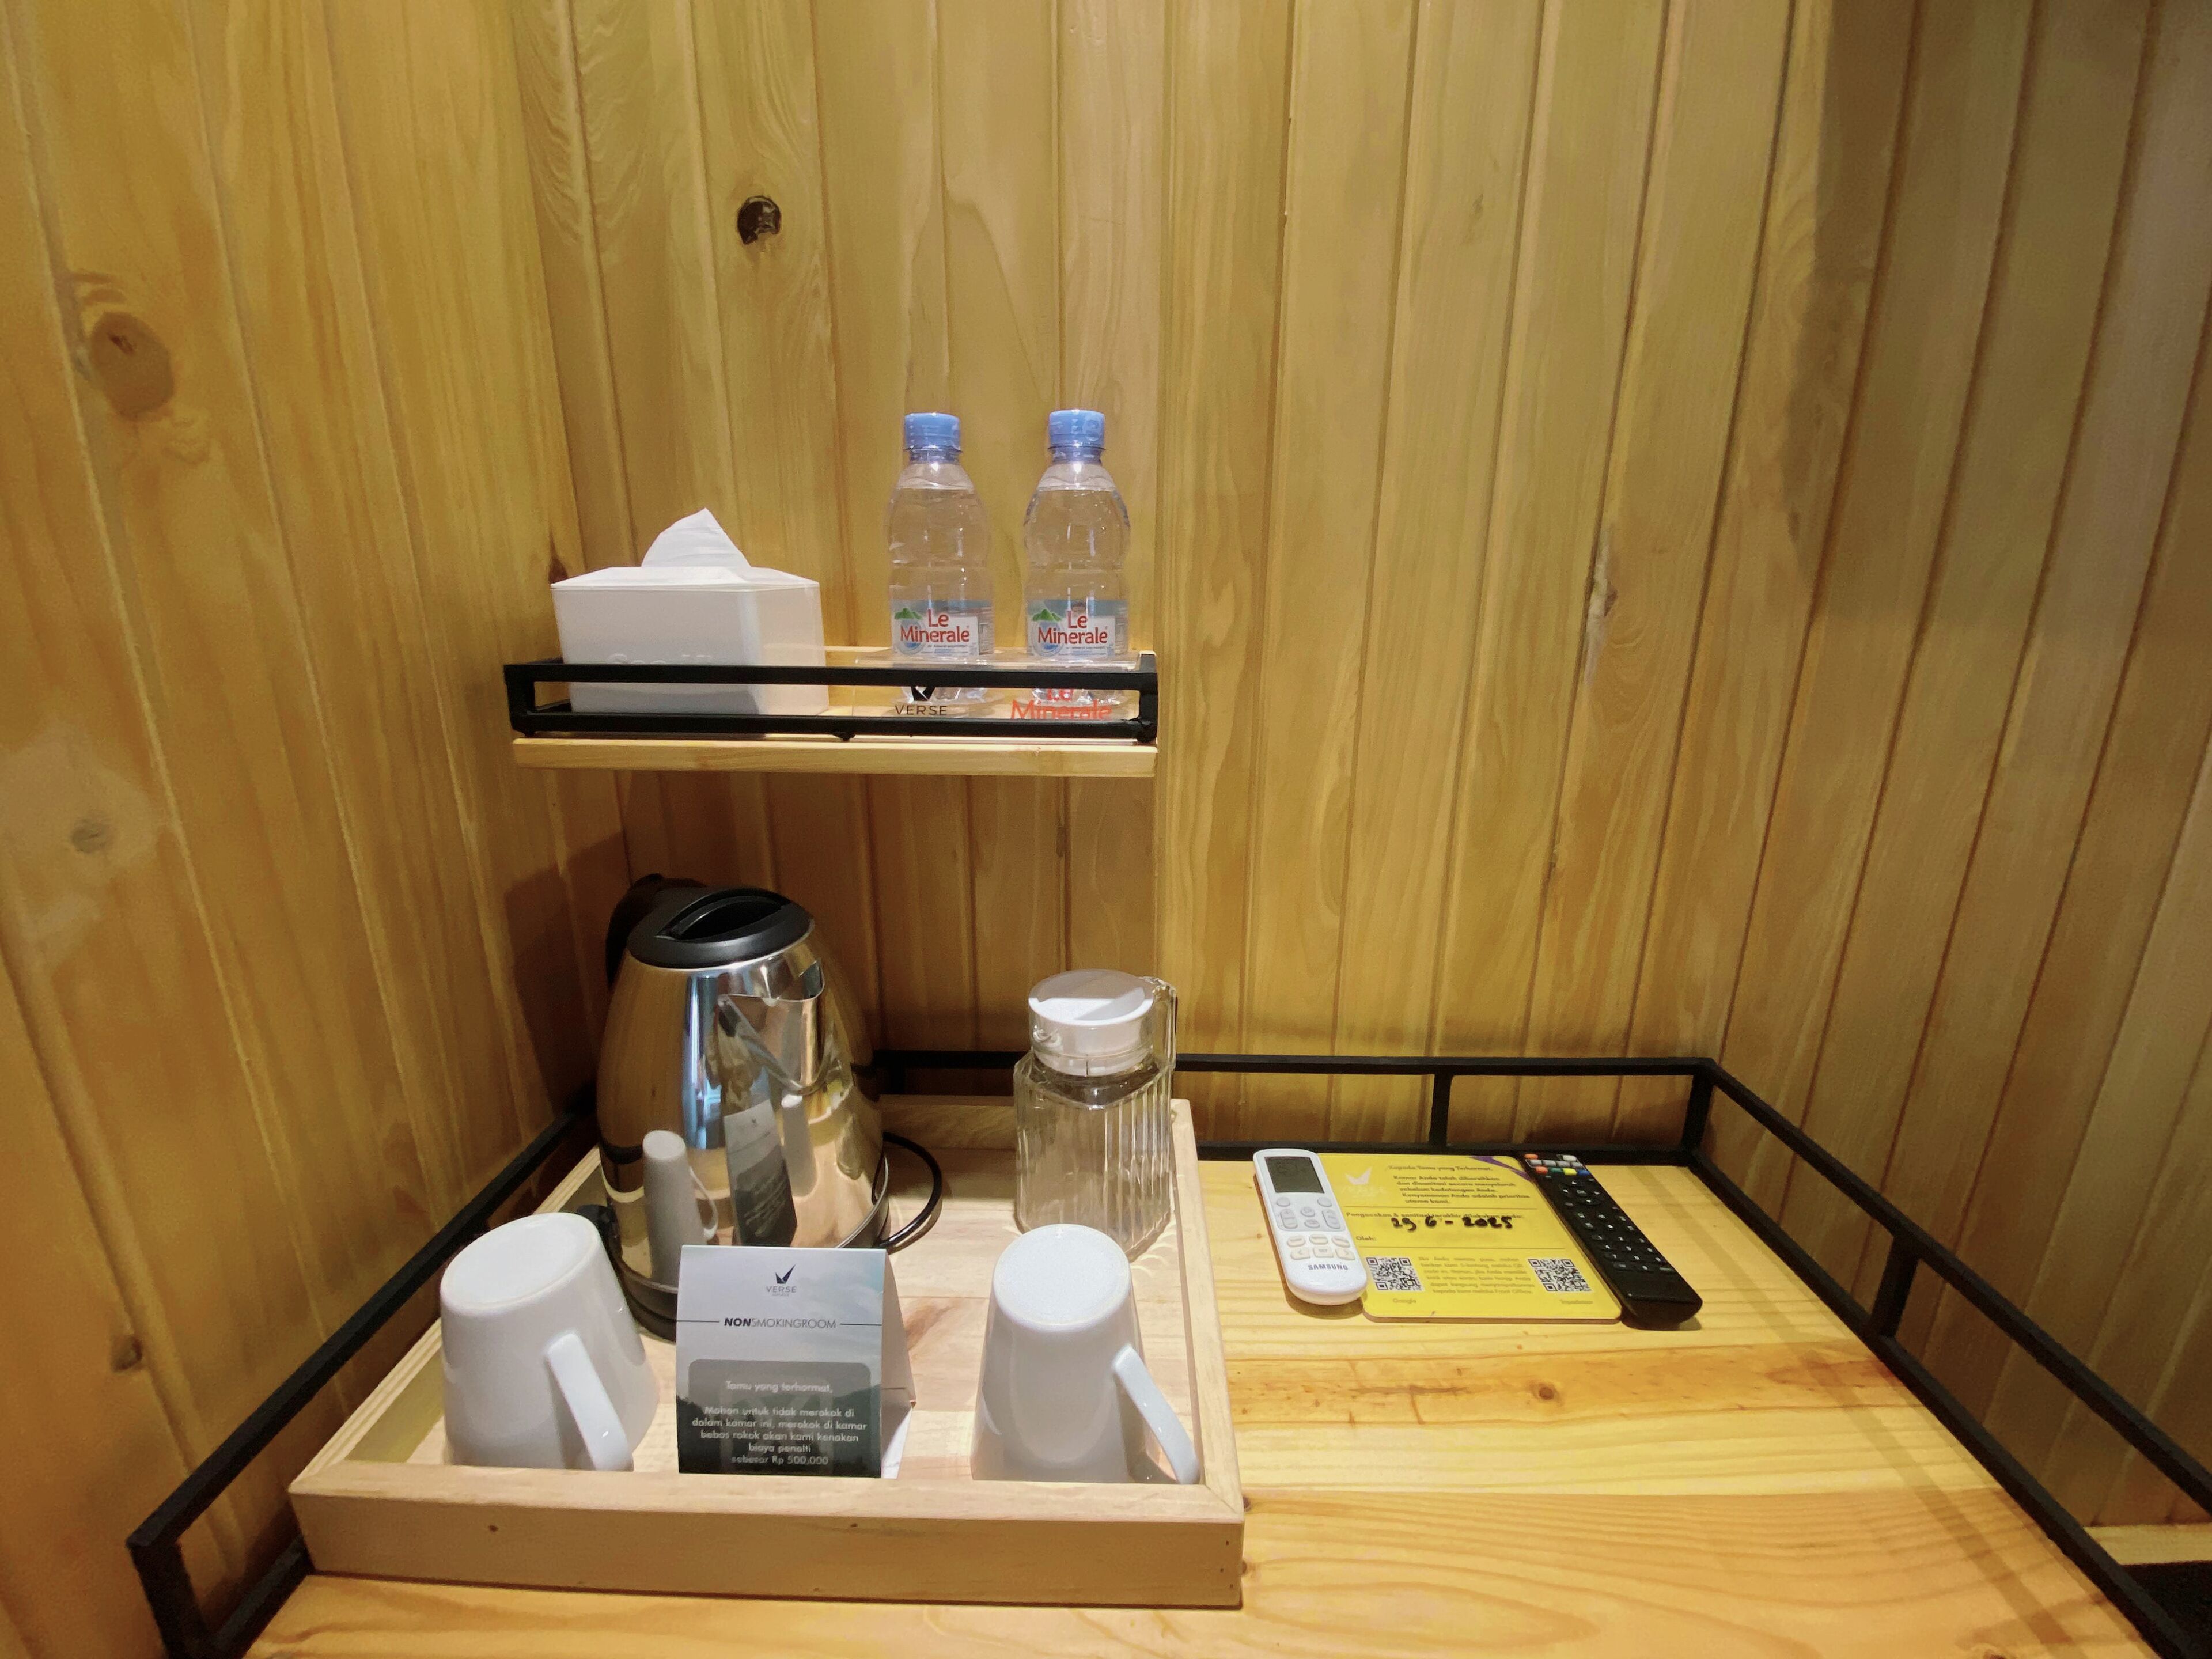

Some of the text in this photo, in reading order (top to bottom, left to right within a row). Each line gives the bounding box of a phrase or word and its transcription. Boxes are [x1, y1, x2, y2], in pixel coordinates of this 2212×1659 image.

[927, 609, 949, 627] Le
[1067, 610, 1087, 628] Le
[900, 626, 970, 642] Minerale
[1038, 627, 1108, 644] Minerale
[895, 704, 947, 715] VERSE
[1011, 699, 1113, 720] Minerale
[1462, 1216, 1513, 1229] 2025
[724, 1317, 836, 1328] NONSMOKINGROOM
[726, 1381, 833, 1394] Tamu yang terhormat,
[703, 1406, 855, 1418] Mohon untuk tidak merokok di
[692, 1418, 723, 1426] dalam
[726, 1418, 757, 1427] kamar
[778, 1420, 821, 1429] merokok
[824, 1421, 833, 1429] di
[836, 1421, 868, 1430] kamar
[700, 1430, 859, 1442] bebas rokok akan kami kenakan
[749, 1442, 812, 1454] biaya penalti
[731, 1455, 769, 1464] sebesar
[772, 1455, 785, 1465] Rp
